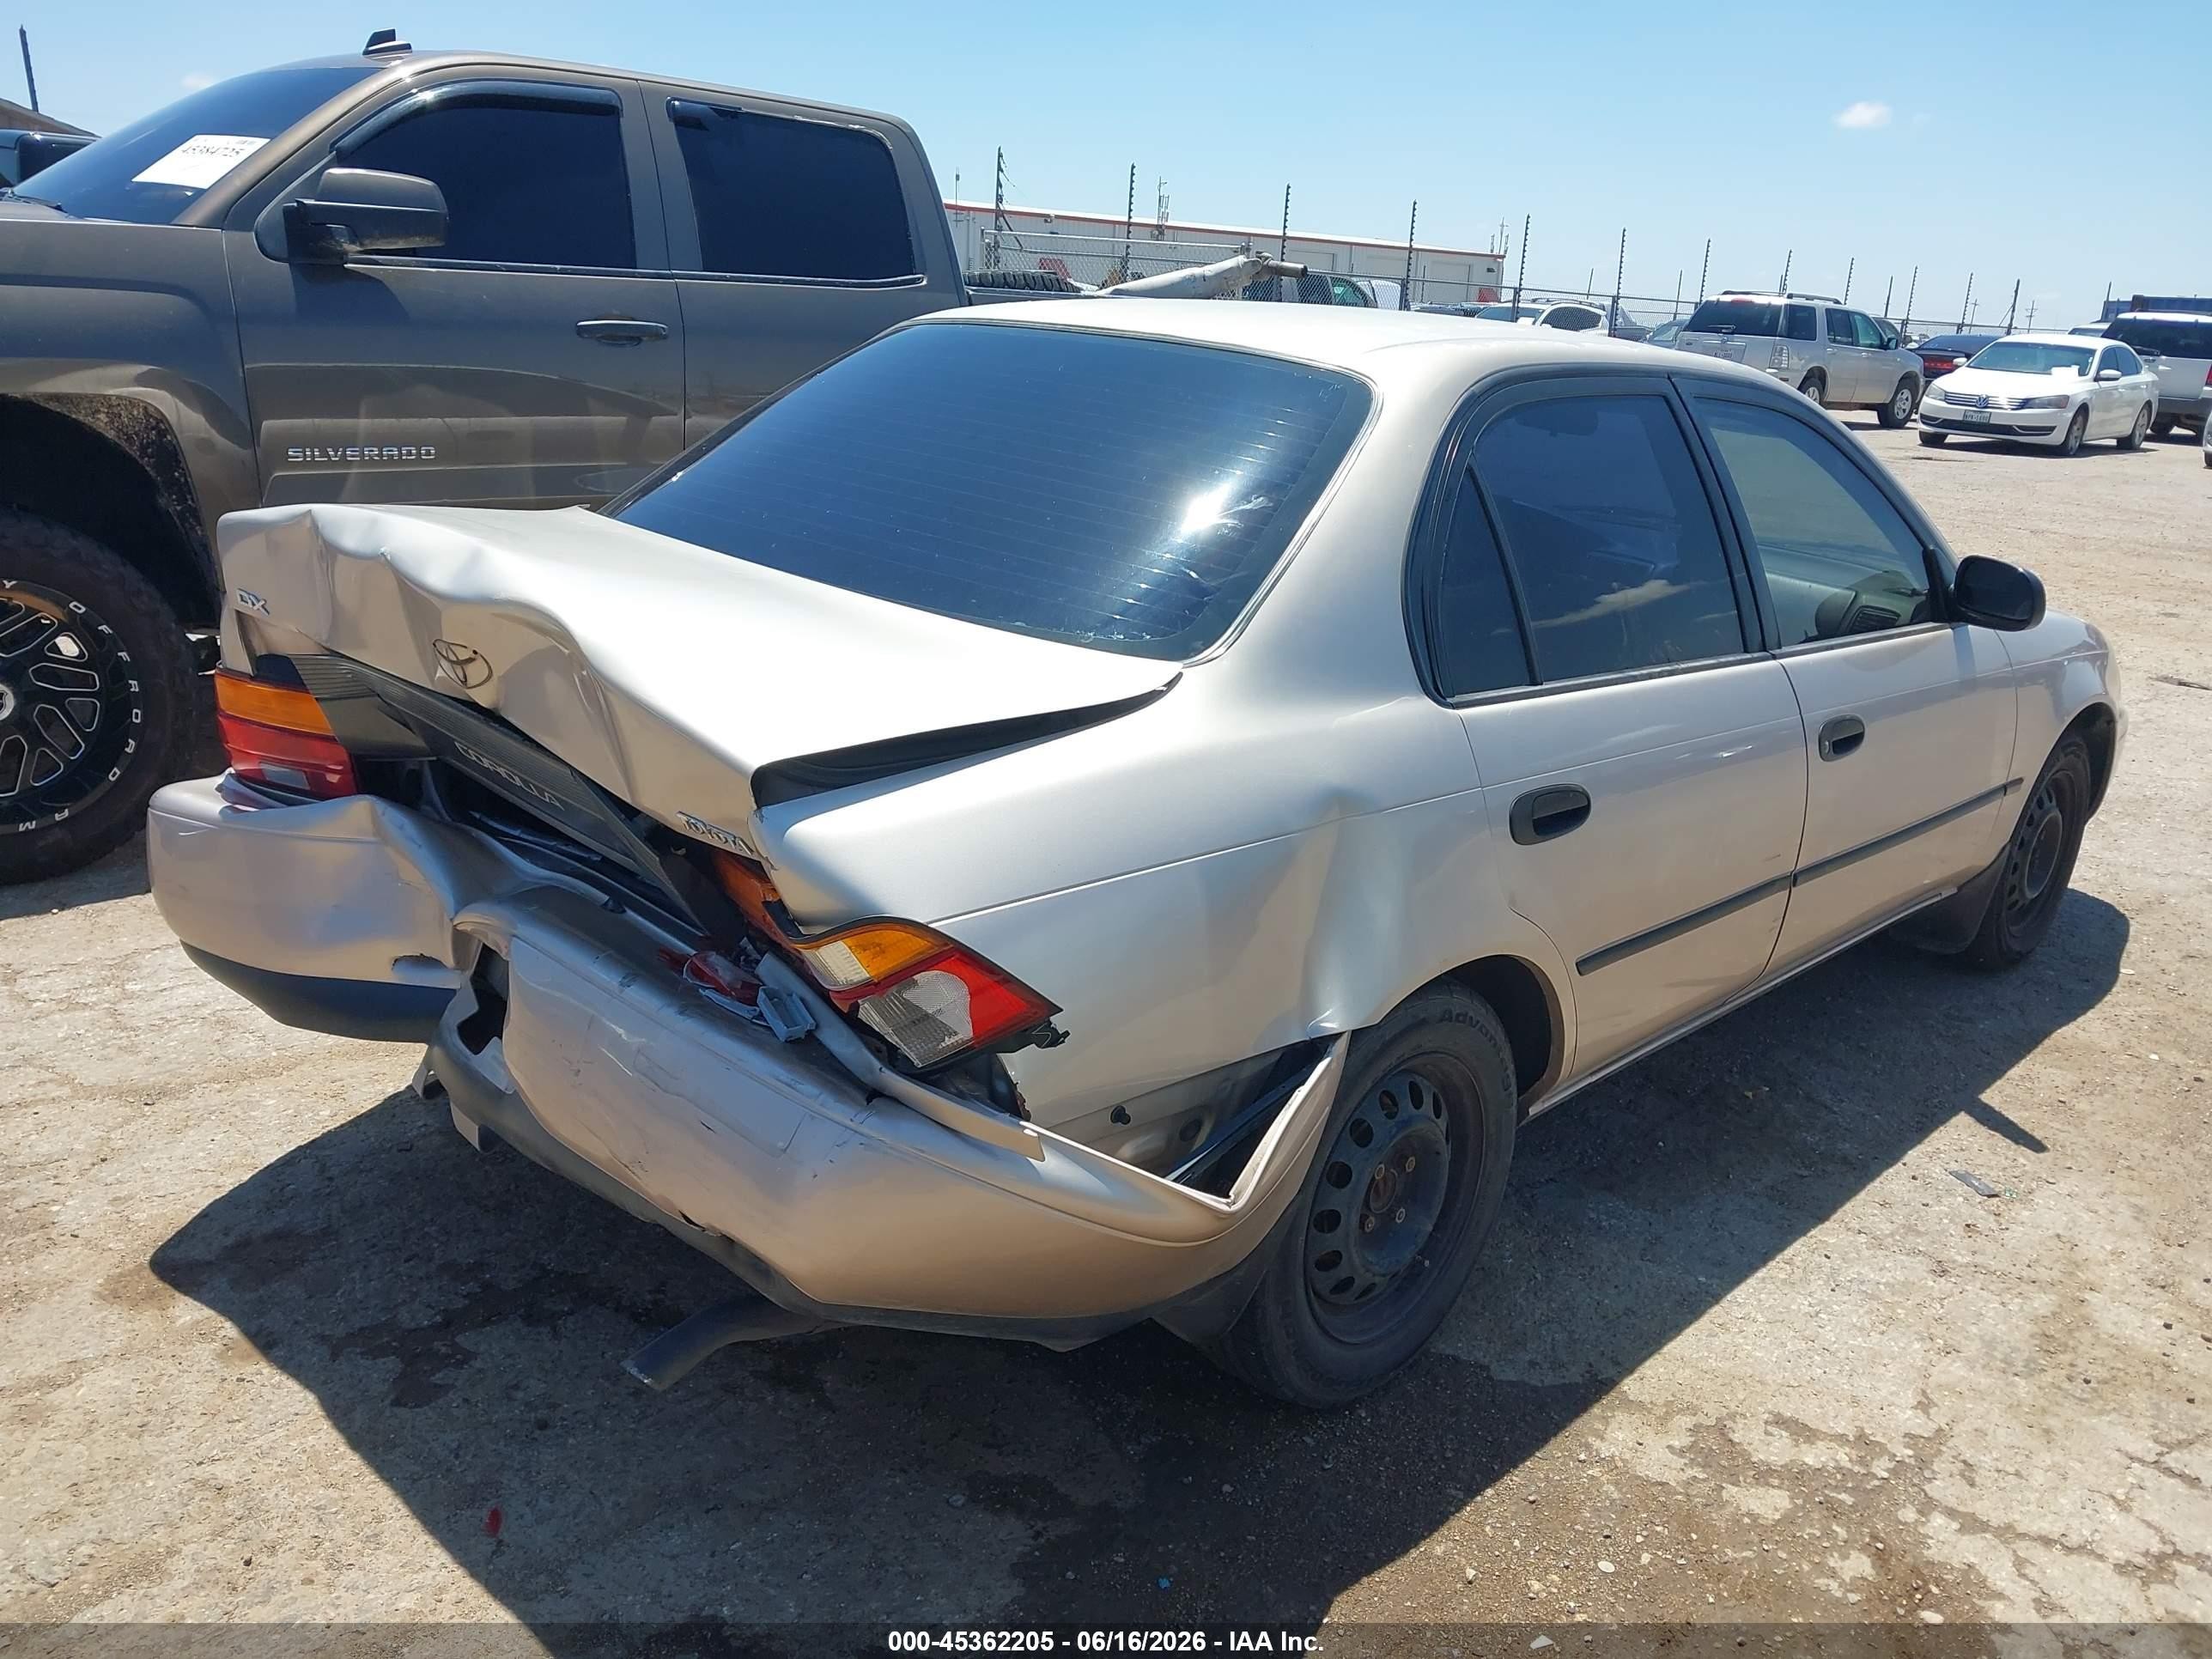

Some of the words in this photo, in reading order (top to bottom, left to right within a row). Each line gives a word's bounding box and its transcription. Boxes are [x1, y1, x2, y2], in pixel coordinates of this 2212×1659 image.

[287, 447, 436, 461] SILVERADO
[236, 588, 270, 616] DX
[454, 741, 565, 811] COROLLA
[676, 811, 755, 856] TOYOTA
